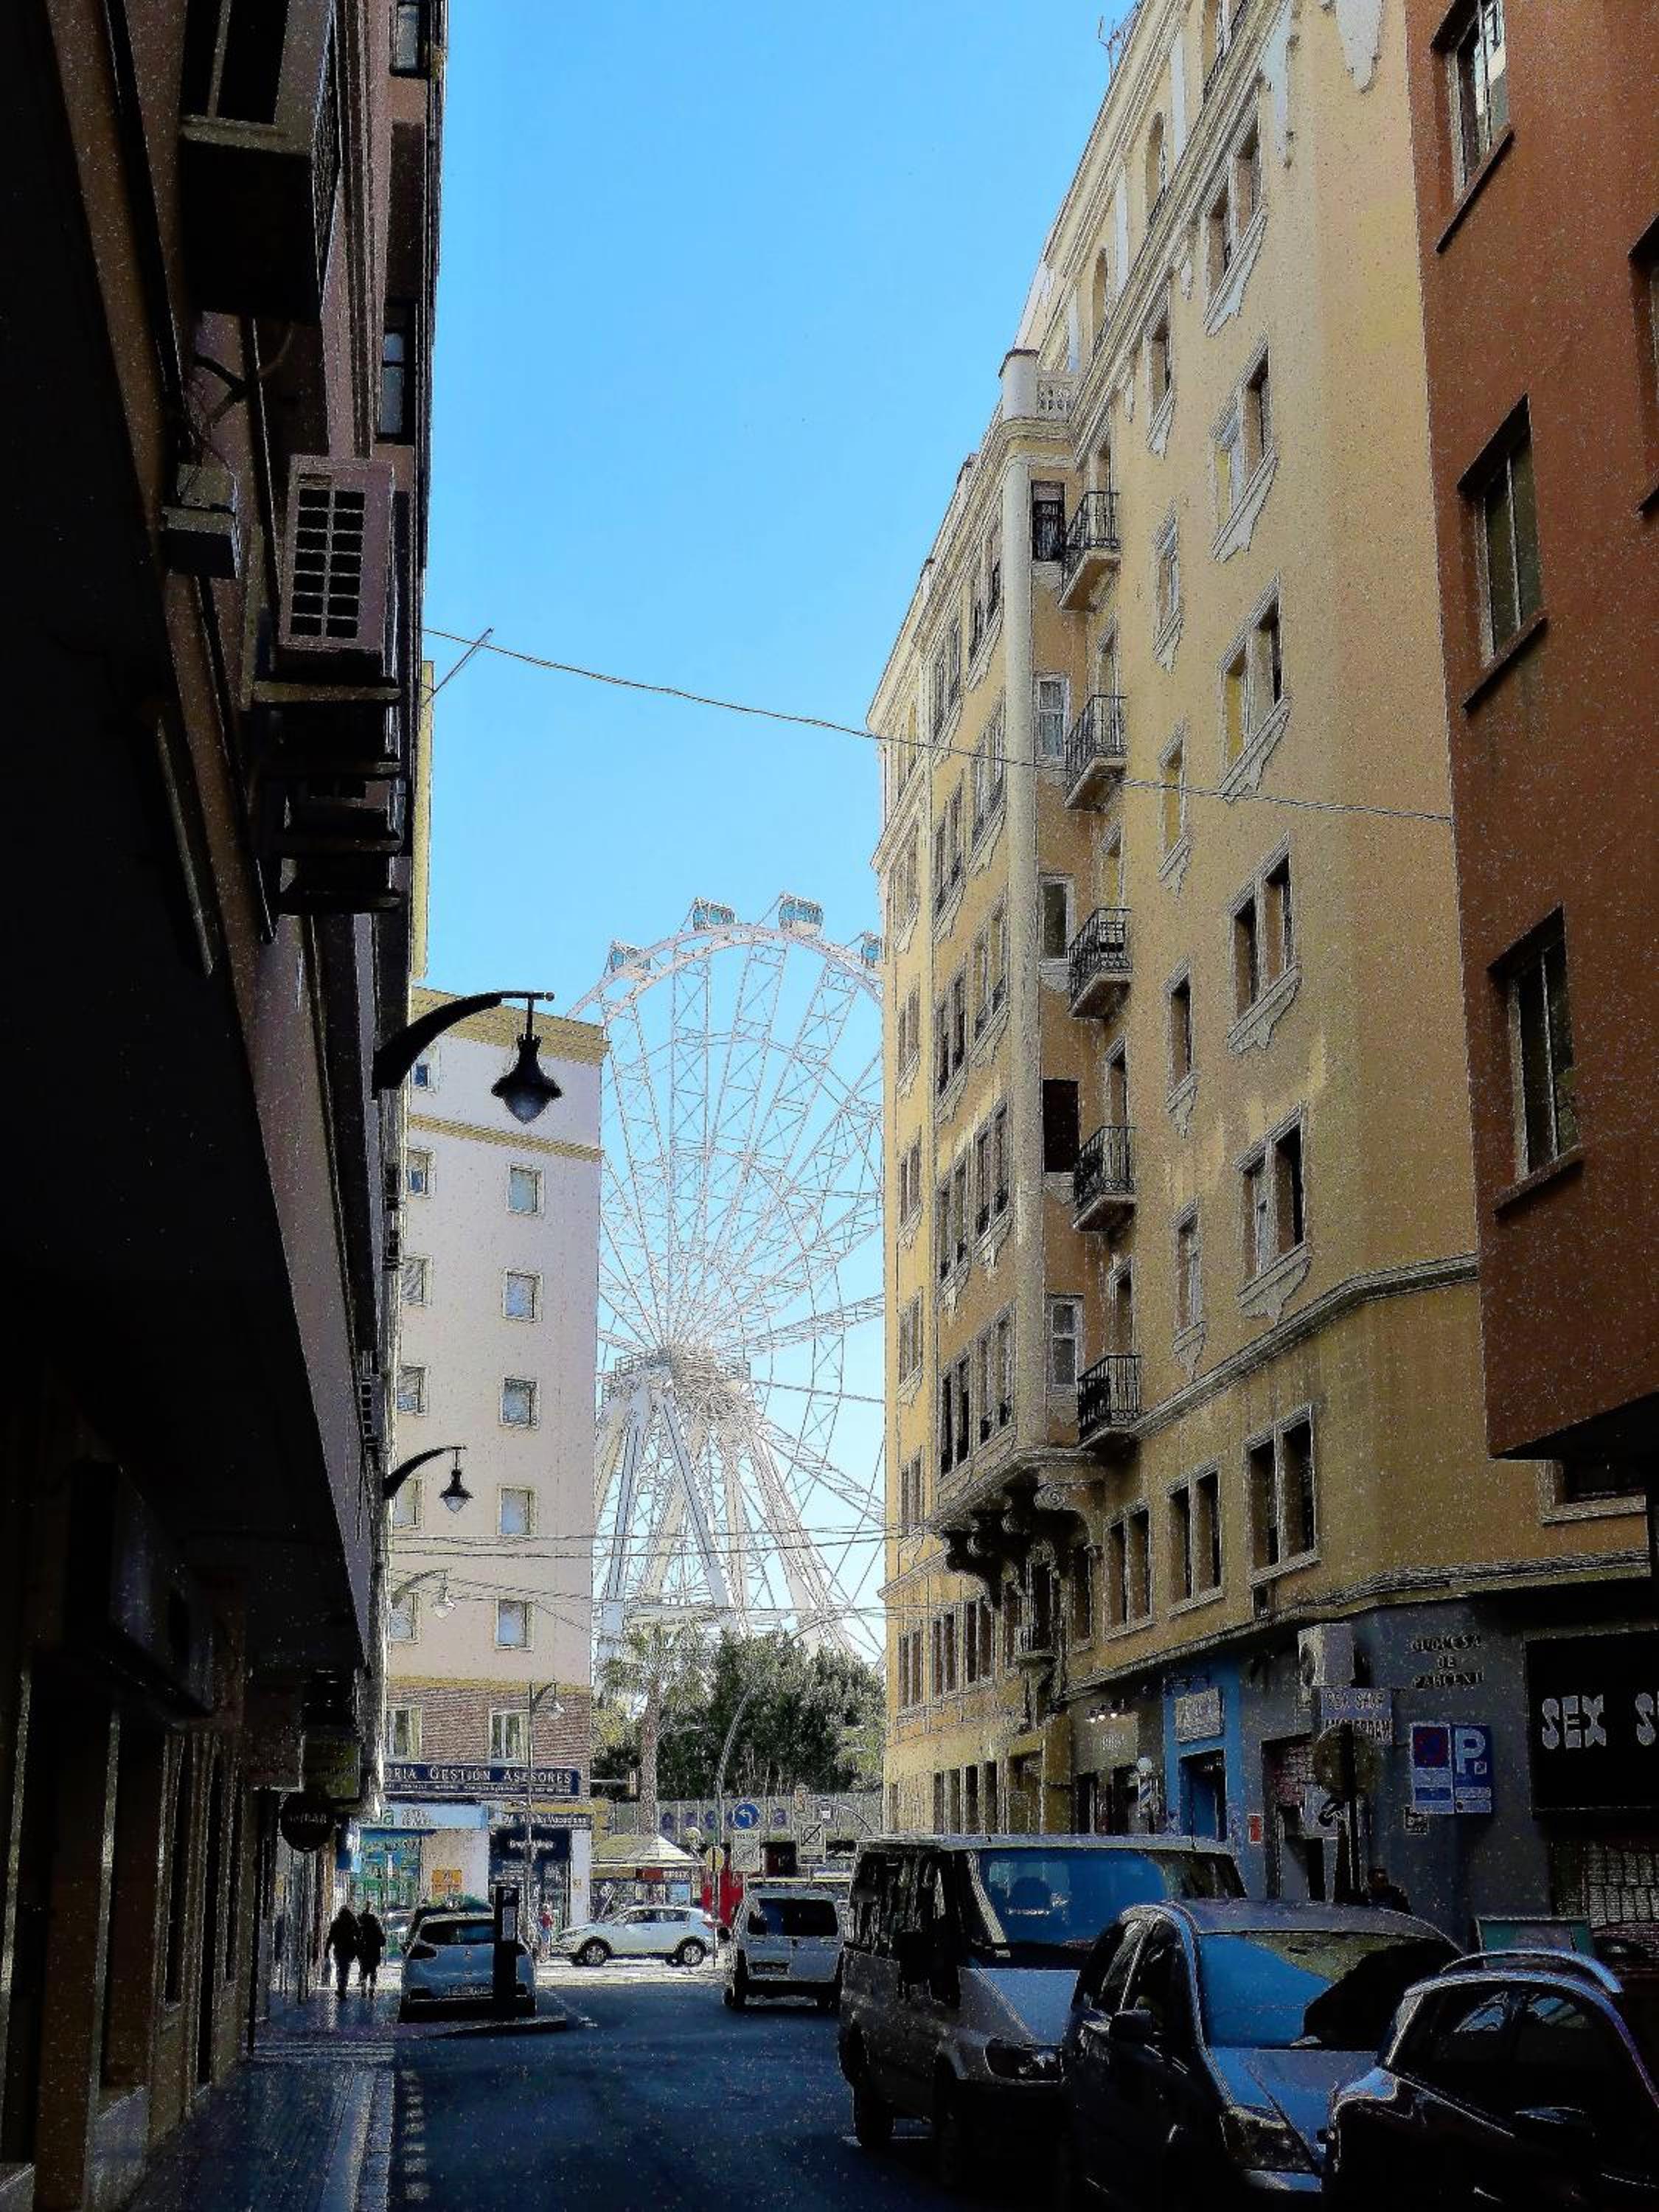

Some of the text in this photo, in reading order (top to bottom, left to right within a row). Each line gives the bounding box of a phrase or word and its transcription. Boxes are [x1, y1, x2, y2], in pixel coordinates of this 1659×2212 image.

[1437, 1654, 1456, 1669] DE
[1542, 1694, 1607, 1750] SEX
[1455, 1728, 1486, 1775] P
[503, 1768, 572, 1784] ASESORES
